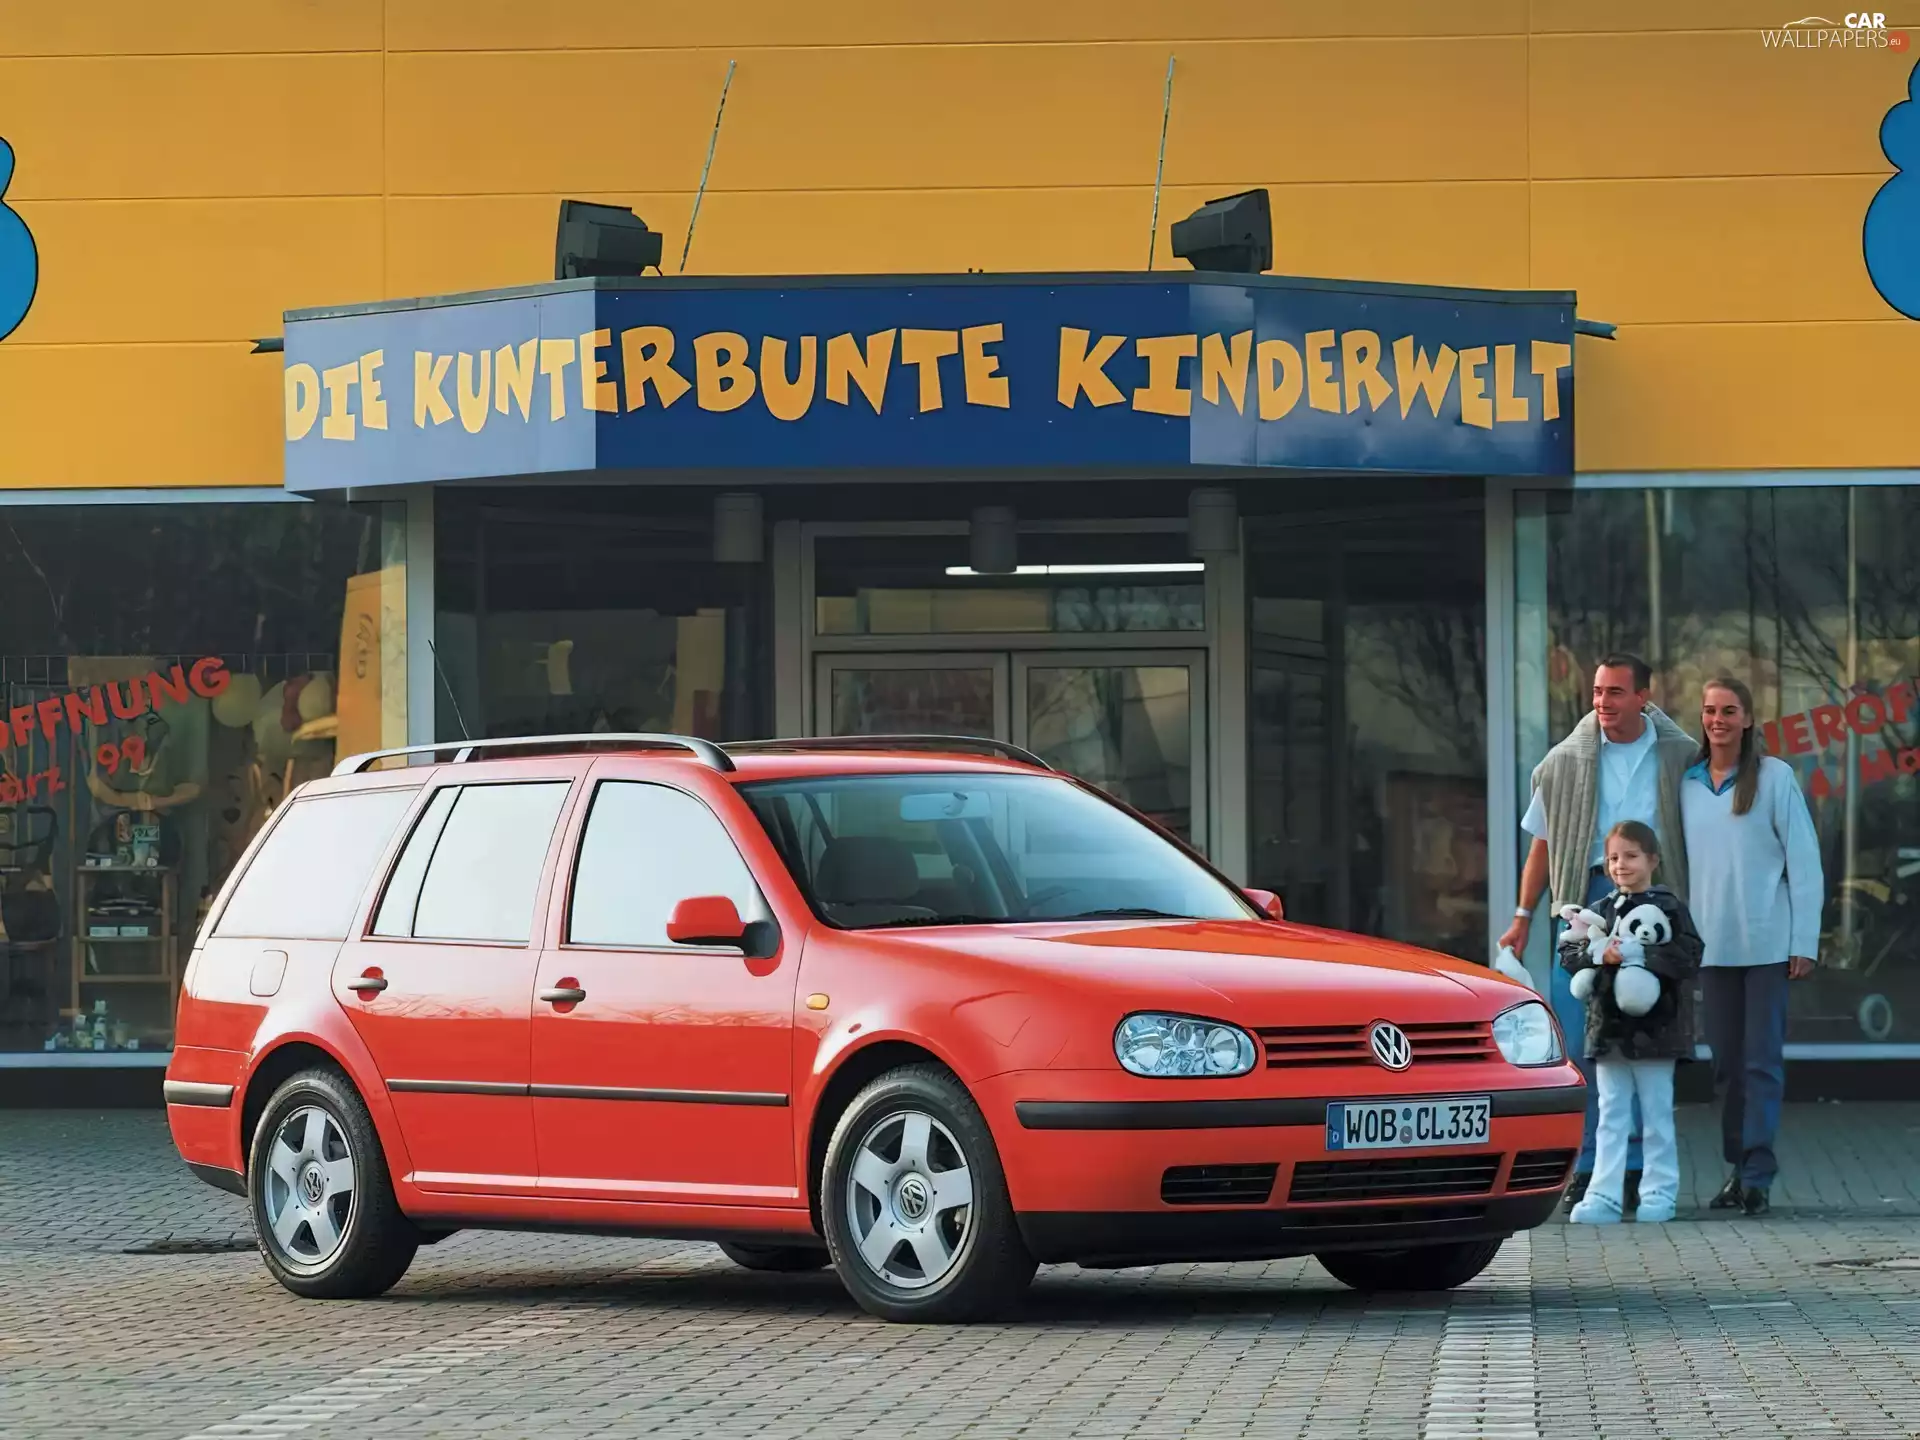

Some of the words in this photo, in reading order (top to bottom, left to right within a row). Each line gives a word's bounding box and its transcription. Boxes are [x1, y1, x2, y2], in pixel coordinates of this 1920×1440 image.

[284, 348, 388, 441] DIE
[414, 323, 1010, 434] KUNTERBUNTE
[1057, 325, 1571, 429] KINDERWELT
[0, 656, 231, 750] FFNUNG
[97, 734, 146, 776] 99
[1346, 1108, 1397, 1143] WOB
